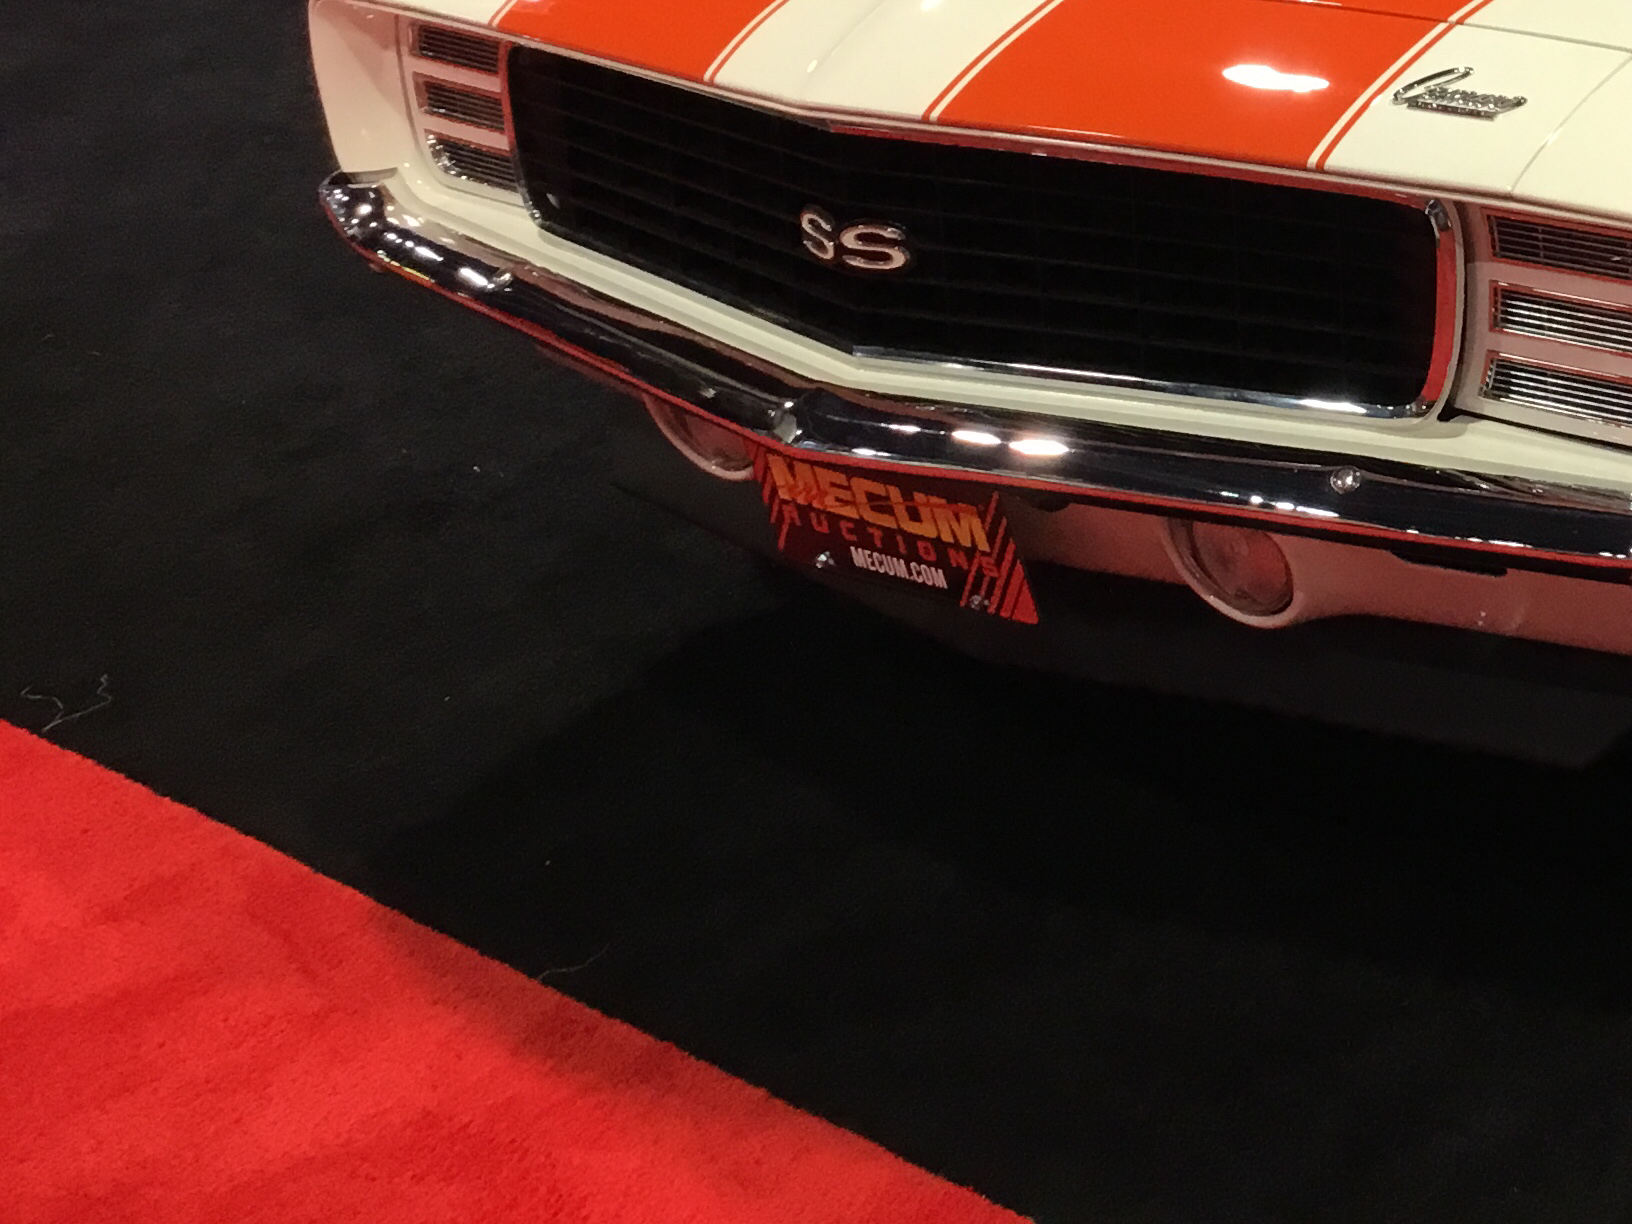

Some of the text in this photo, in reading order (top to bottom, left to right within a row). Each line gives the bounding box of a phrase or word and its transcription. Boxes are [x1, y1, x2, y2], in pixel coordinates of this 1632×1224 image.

[801, 212, 911, 270] SS
[766, 453, 991, 553] MECUM
[782, 502, 1000, 577] AUCTIONS
[850, 545, 949, 590] MECUM.COM
